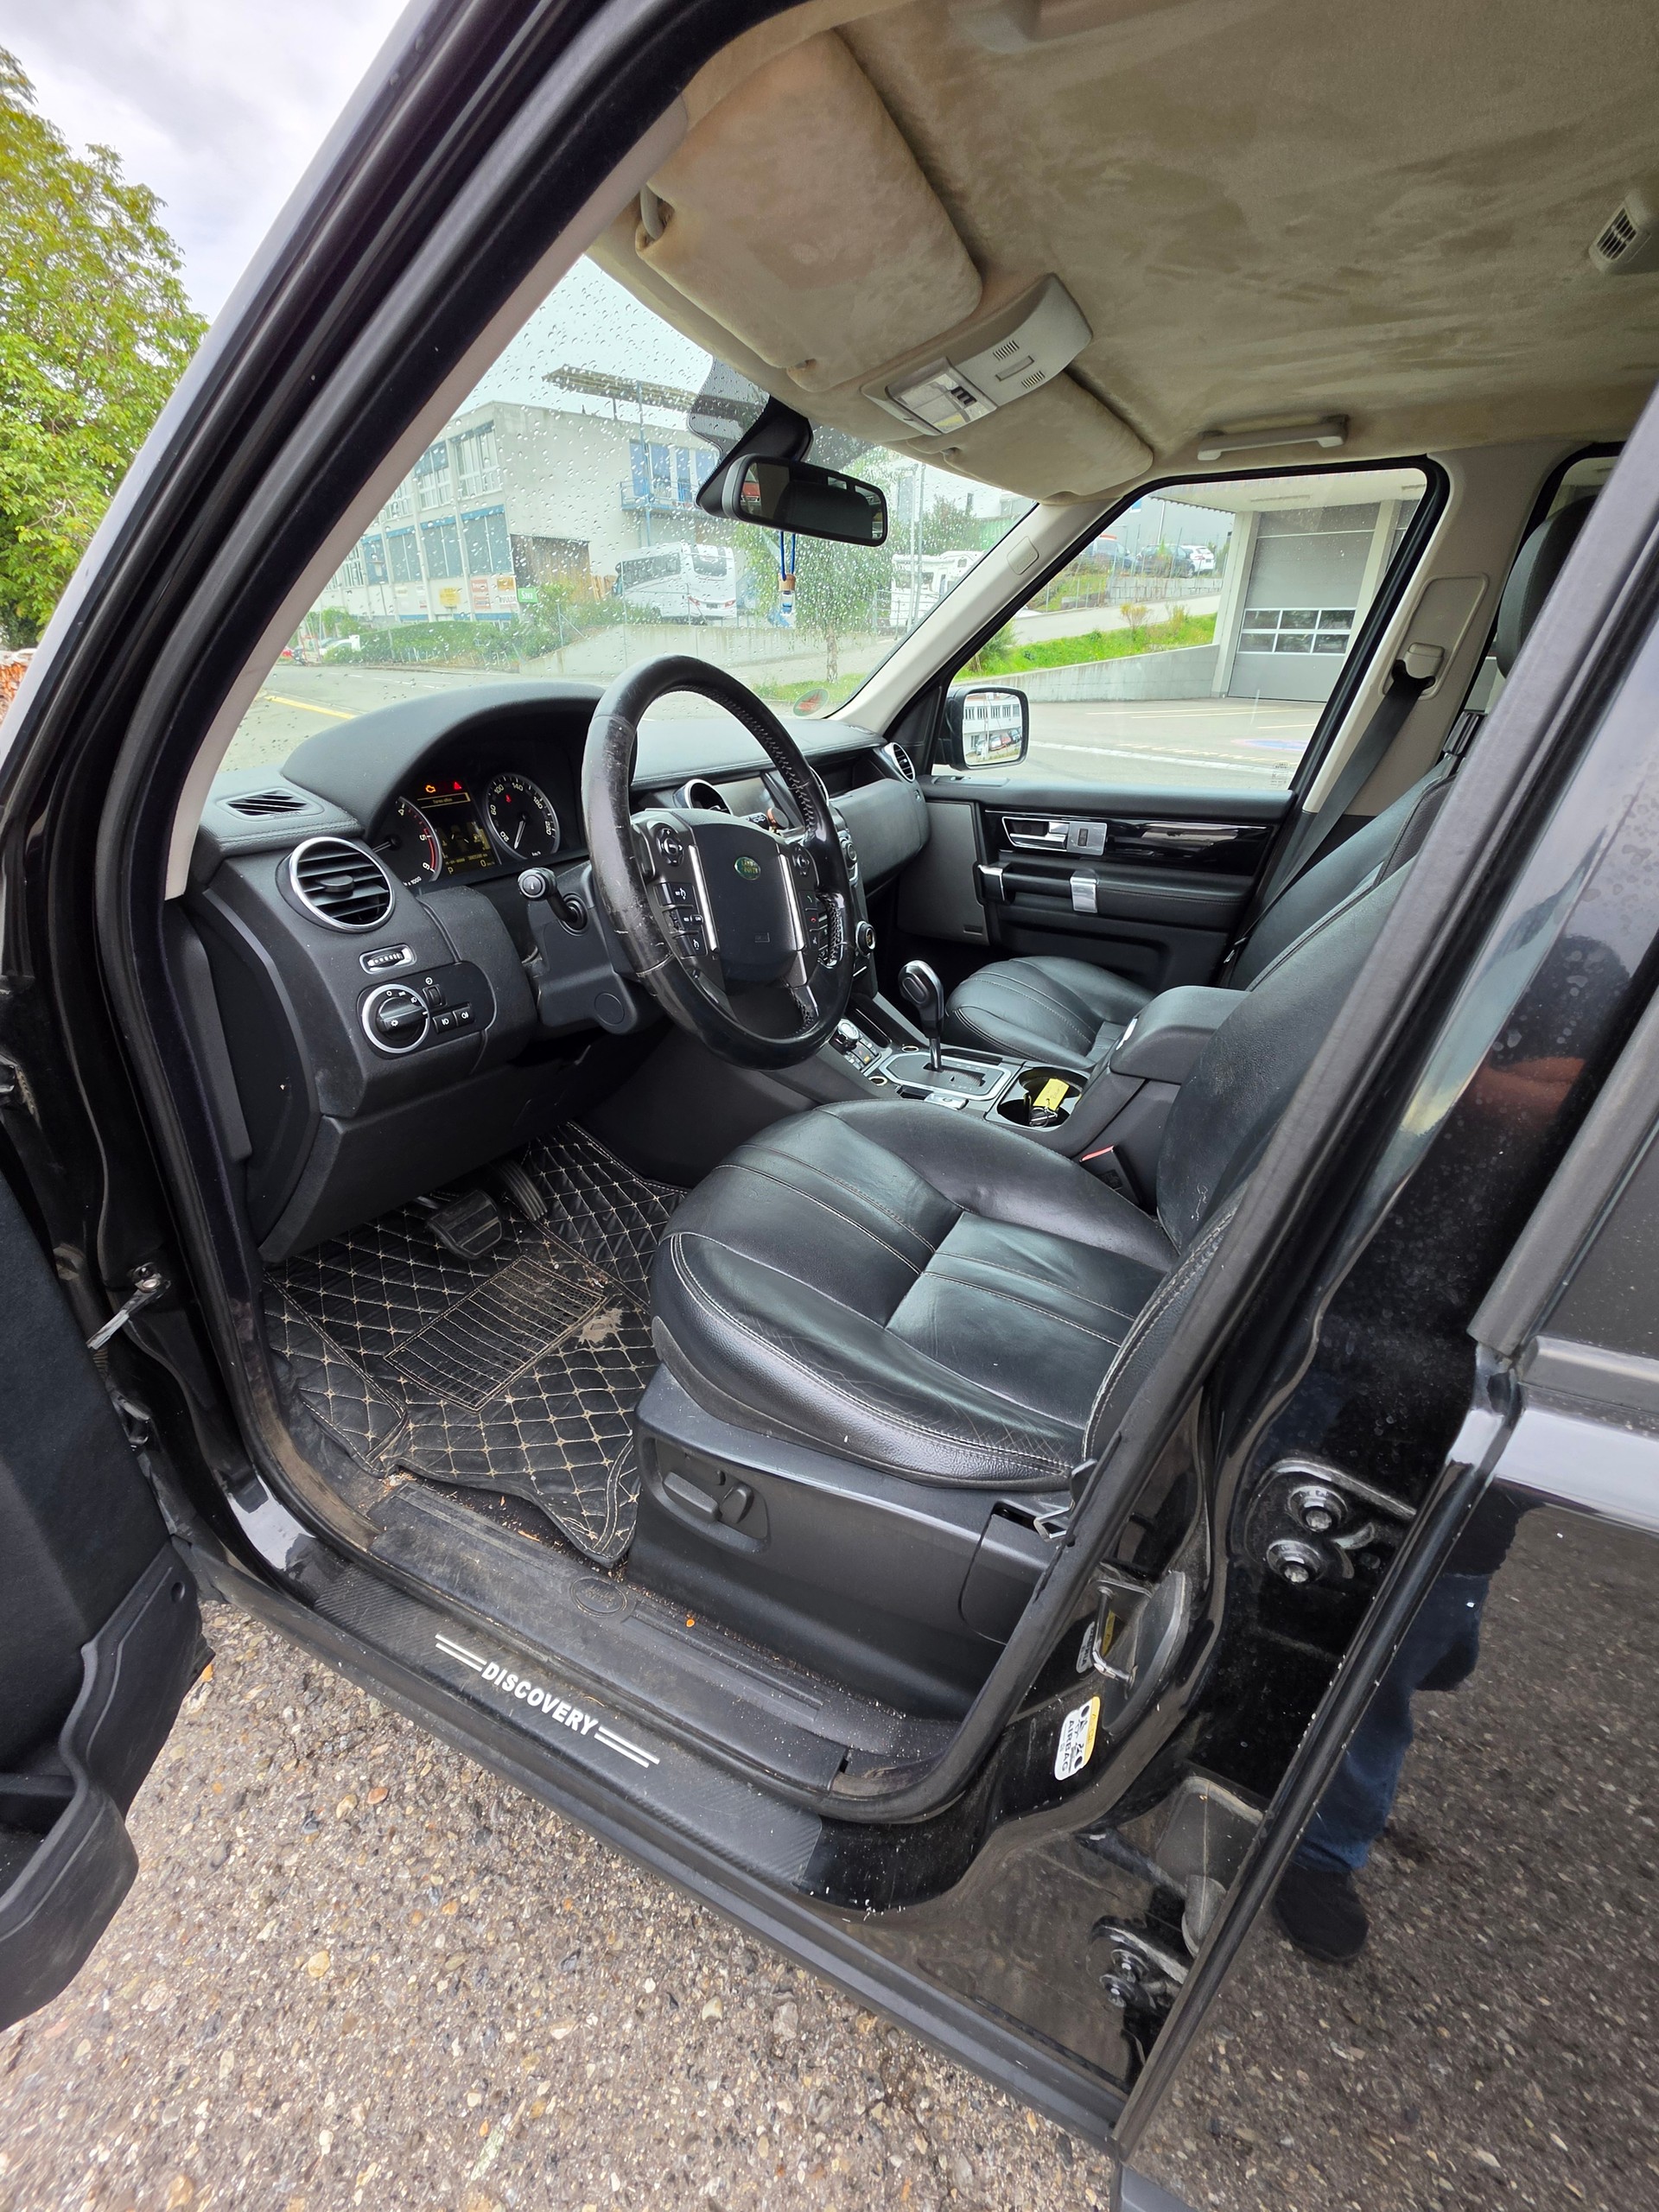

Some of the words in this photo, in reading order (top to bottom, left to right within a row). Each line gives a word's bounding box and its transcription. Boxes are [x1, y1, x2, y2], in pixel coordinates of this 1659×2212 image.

[494, 784, 505, 794] 100
[512, 782, 524, 791] 140
[533, 796, 543, 810] 180
[490, 804, 497, 816] 60
[499, 830, 510, 842] 20
[422, 861, 430, 870] 6
[447, 867, 454, 875] P
[410, 875, 423, 885] 1000
[481, 1661, 599, 1737] DISCOVERY
[1062, 1719, 1075, 1772] AIRBAG
